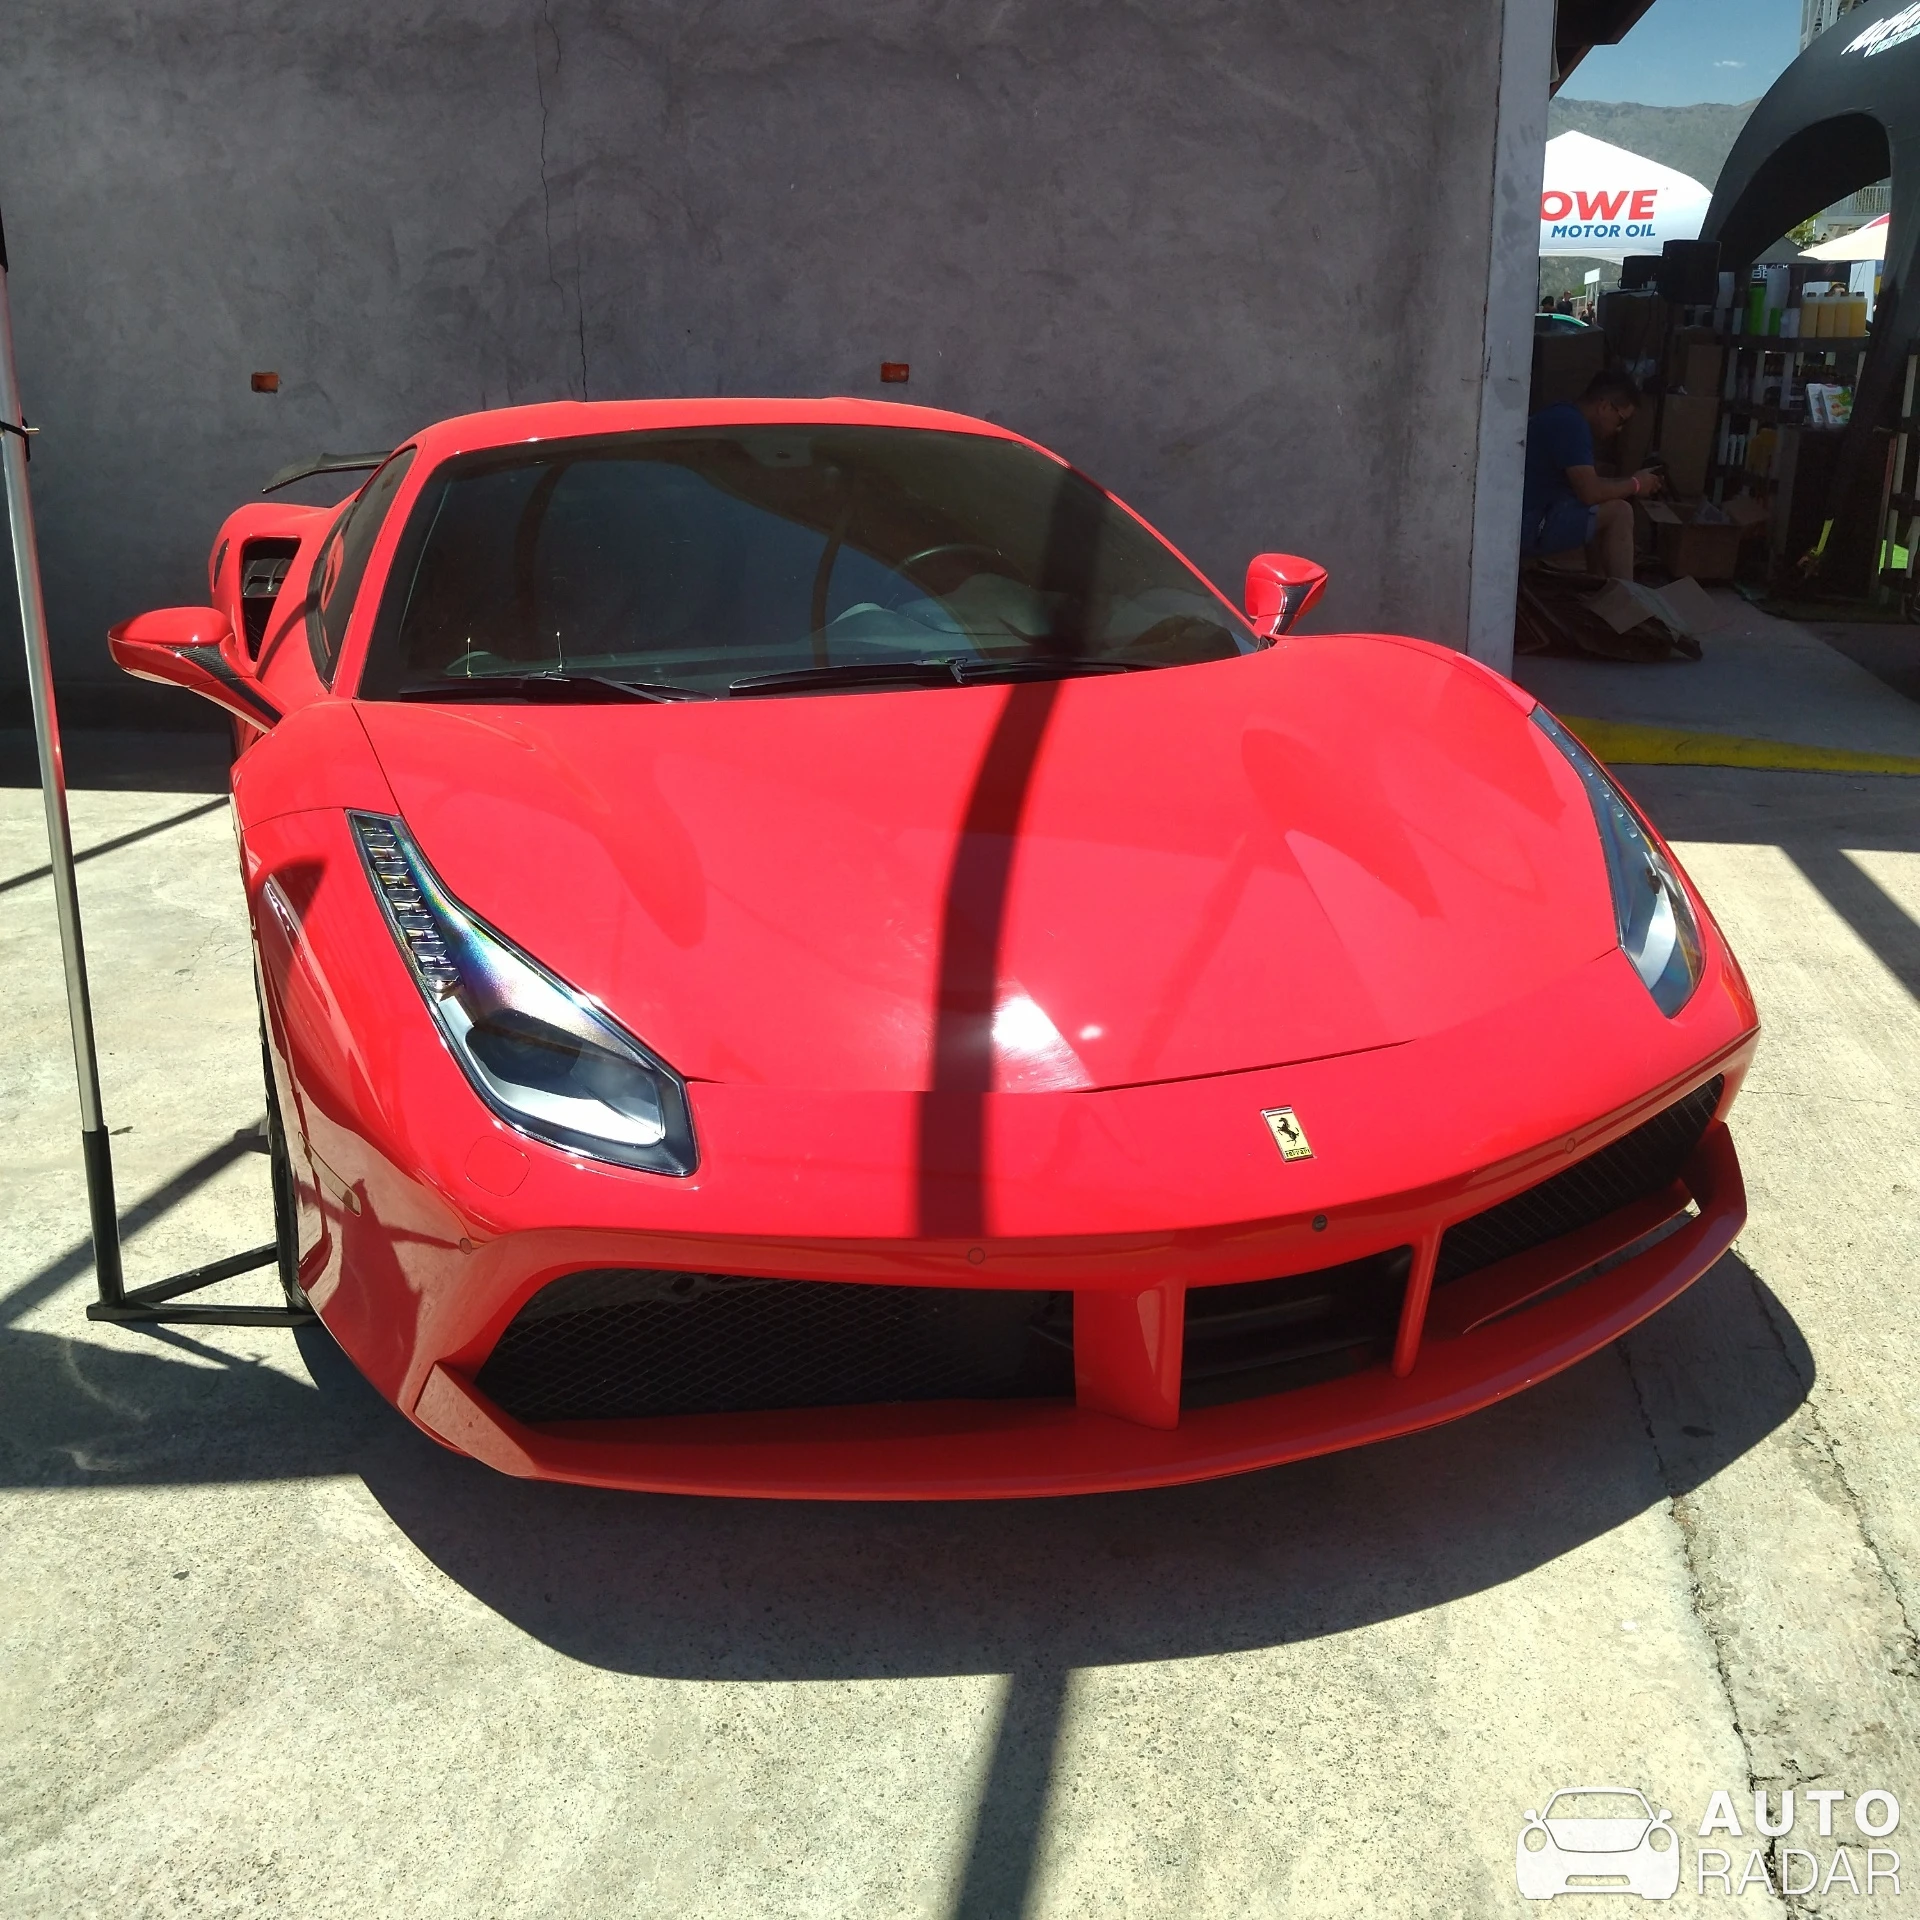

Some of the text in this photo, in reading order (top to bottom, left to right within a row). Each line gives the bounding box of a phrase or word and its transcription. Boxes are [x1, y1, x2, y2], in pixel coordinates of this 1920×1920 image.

[1541, 189, 1658, 221] OWE
[1551, 224, 1656, 238] MOTOR OIL
